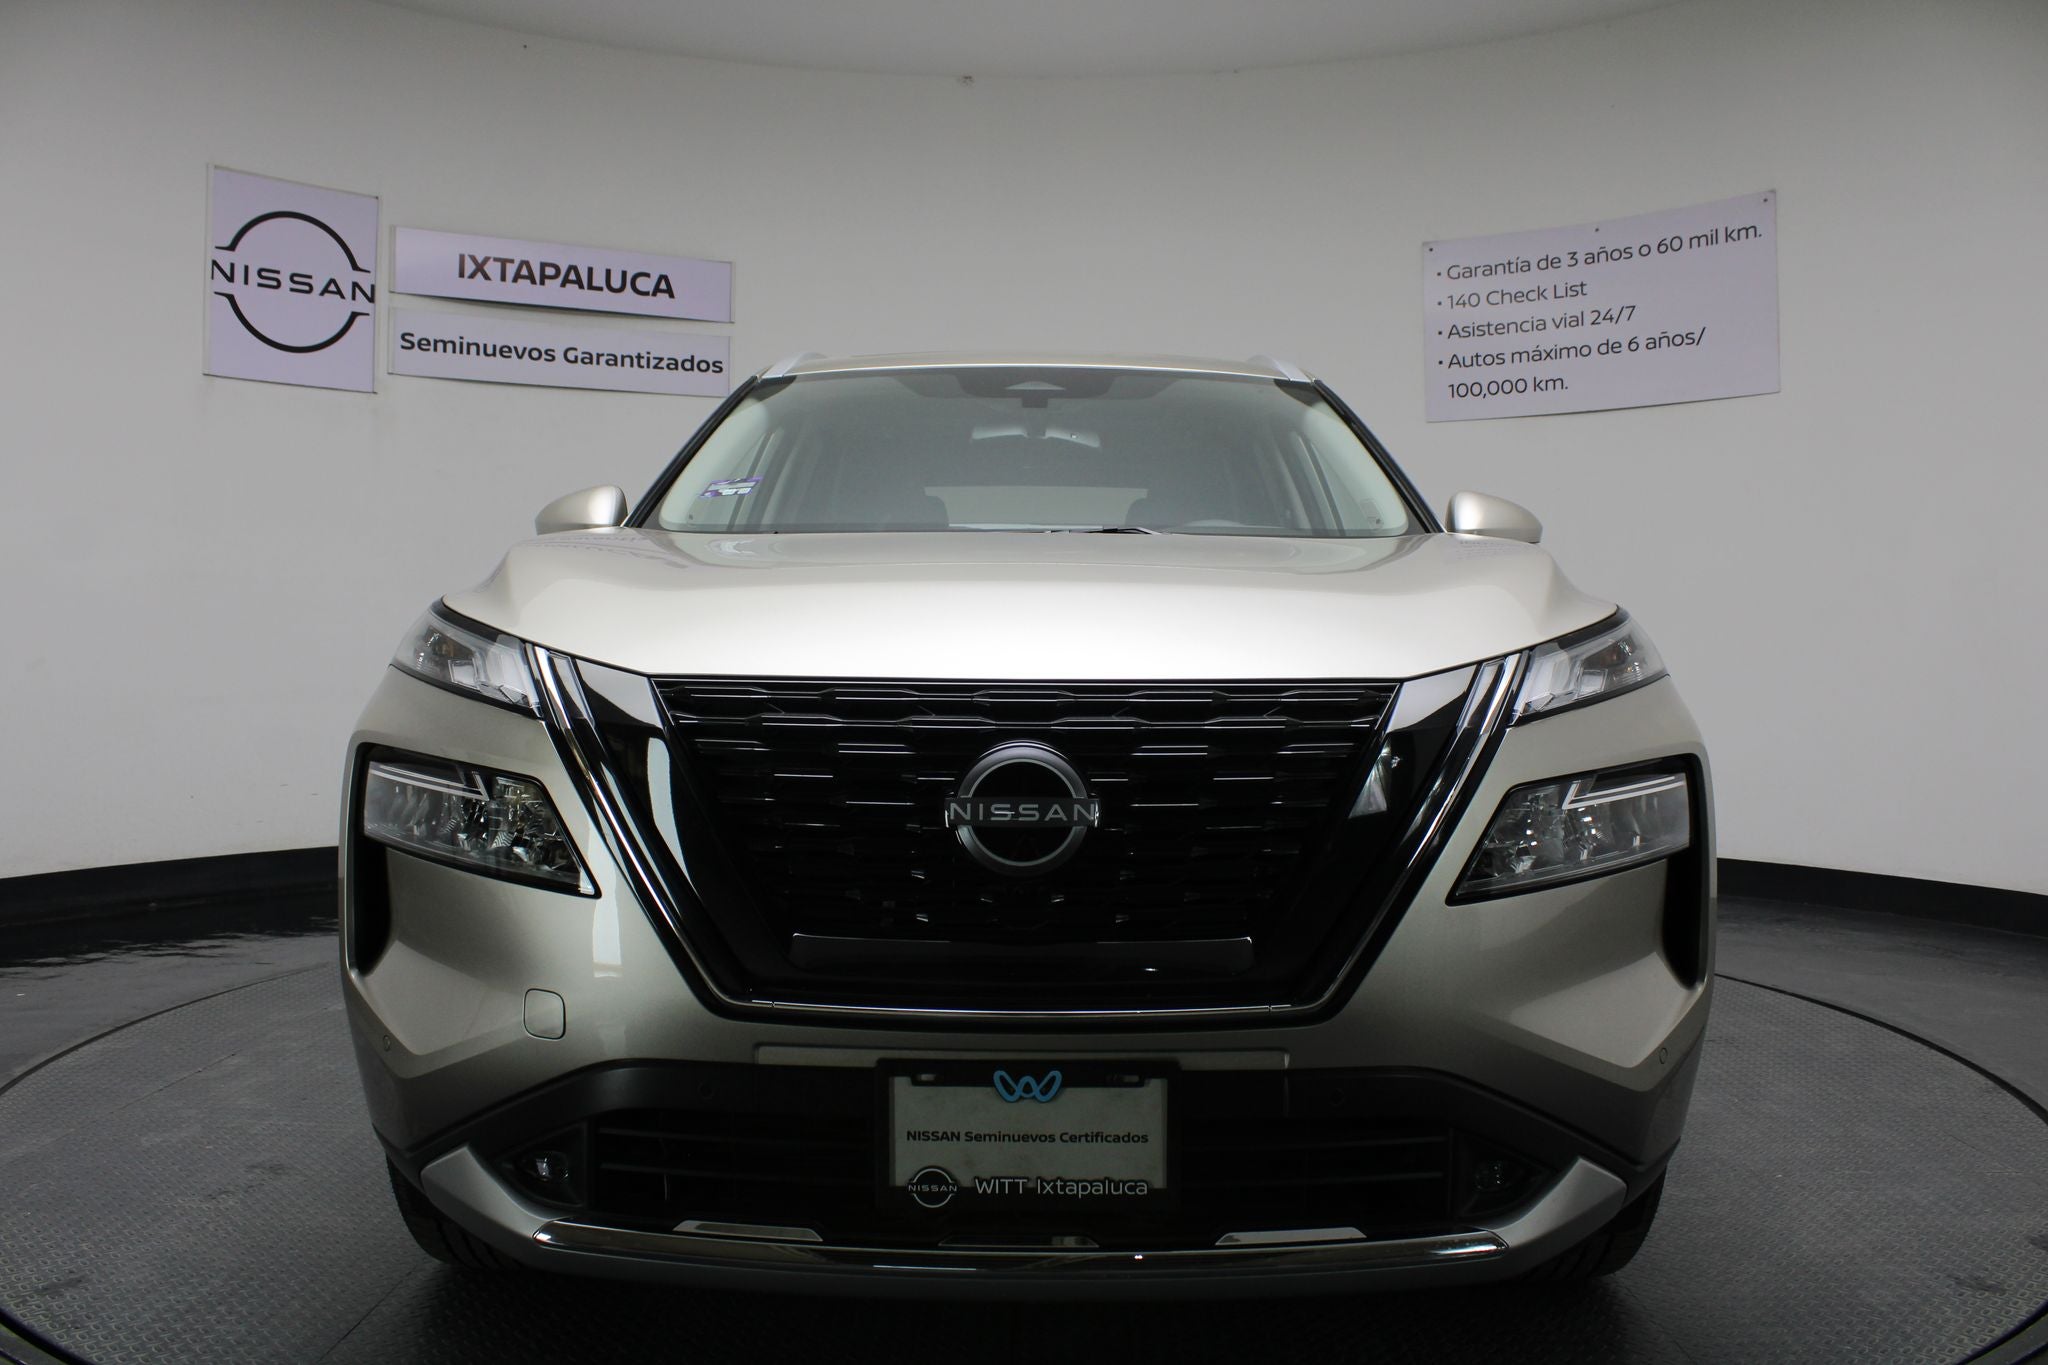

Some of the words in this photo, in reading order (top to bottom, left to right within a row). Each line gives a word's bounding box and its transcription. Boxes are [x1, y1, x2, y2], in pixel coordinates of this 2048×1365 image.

[1447, 256, 1531, 280] Garantía
[1537, 255, 1562, 271] de
[1567, 251, 1579, 268] 3
[1584, 245, 1633, 265] años
[1639, 243, 1652, 257] o
[1657, 236, 1683, 255] 60
[1689, 229, 1719, 250] mil
[1725, 224, 1763, 244] km.
[211, 259, 375, 304] NISSAN
[458, 253, 675, 299] IXTAPALUCA
[1448, 292, 1481, 309] 140
[1486, 286, 1548, 305] Check
[1553, 280, 1587, 299] List
[1448, 316, 1546, 339] Asistencia
[1552, 311, 1585, 330] vial
[1591, 305, 1636, 325] 24/7
[400, 332, 556, 363] Seminuevos
[563, 346, 724, 375] Garantizados
[1448, 350, 1506, 369] Autos
[1511, 342, 1592, 364] máximo
[1597, 340, 1622, 355] de
[1628, 335, 1640, 352] 6
[1645, 327, 1706, 350] años/
[1448, 377, 1528, 399] 100,000
[1533, 376, 1569, 393] km.
[950, 803, 1095, 821] NISSAN
[906, 1130, 961, 1143] NISSAN
[964, 1131, 1056, 1144] Seminuevos
[1059, 1131, 1149, 1144] Certificados
[908, 1184, 958, 1193] NISSAN
[974, 1178, 1029, 1195] WITT
[1037, 1179, 1148, 1199] Ixtapaluca
